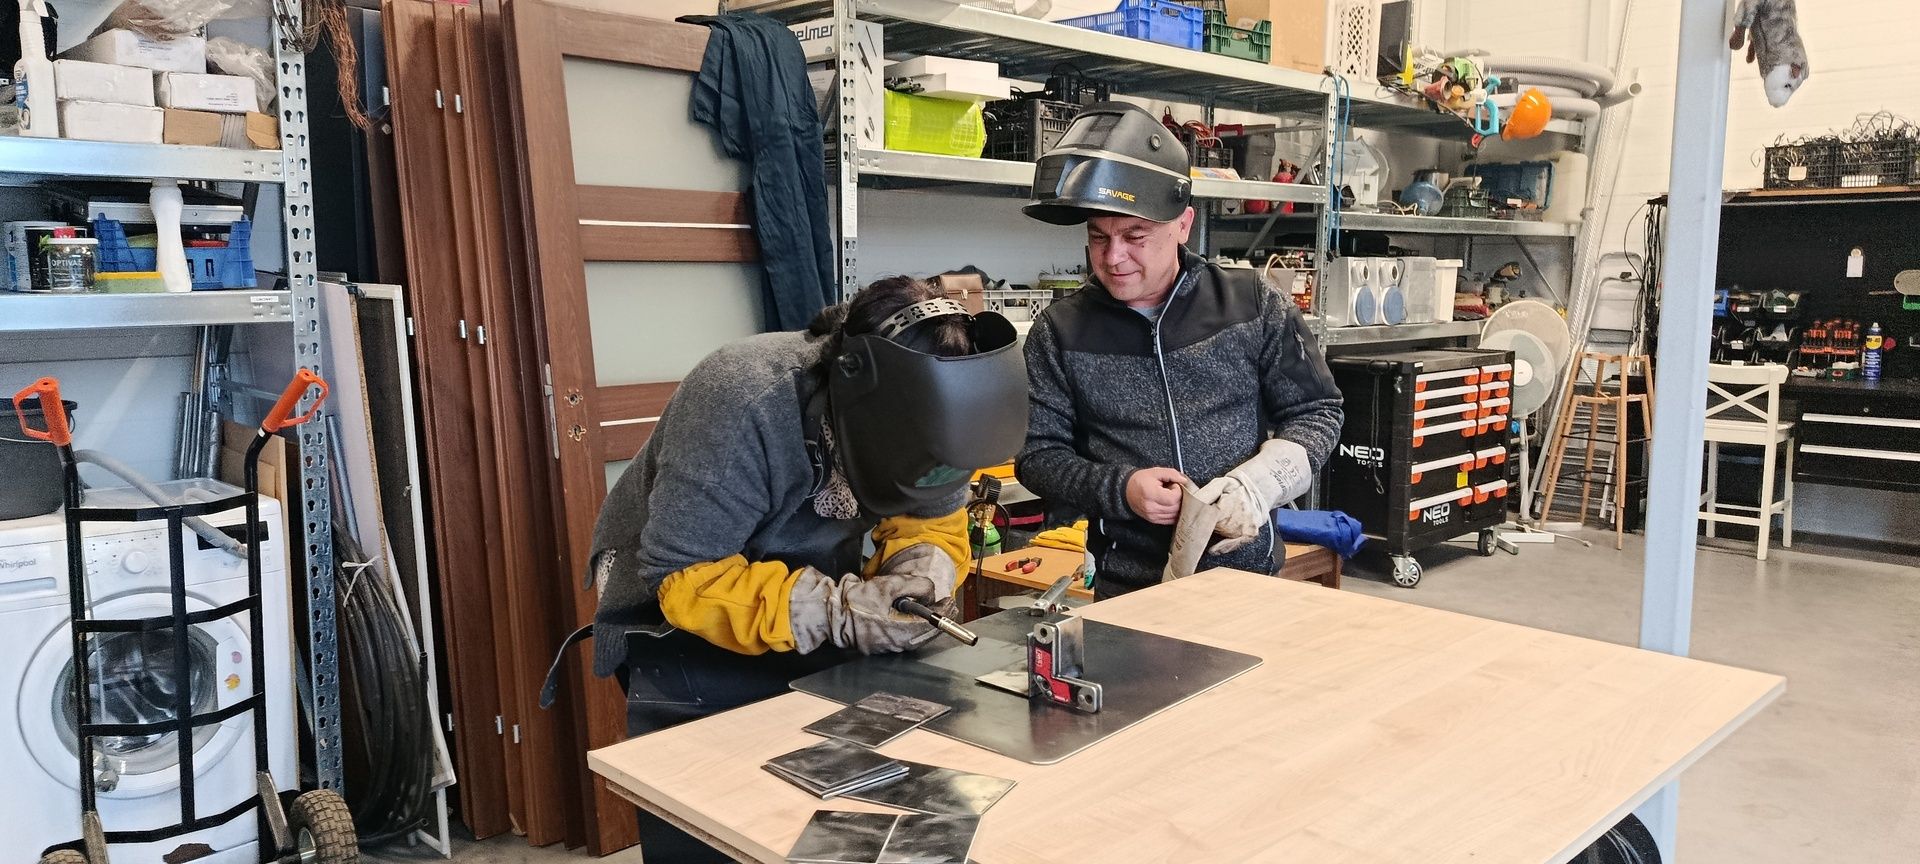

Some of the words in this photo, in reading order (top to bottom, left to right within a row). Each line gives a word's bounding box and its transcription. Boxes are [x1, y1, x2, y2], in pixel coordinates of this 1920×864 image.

[795, 24, 835, 41] elmer
[1098, 187, 1136, 202] SAVAGE
[1340, 443, 1385, 461] NEO
[1423, 502, 1450, 523] NEO
[1433, 516, 1449, 526] TOOLS
